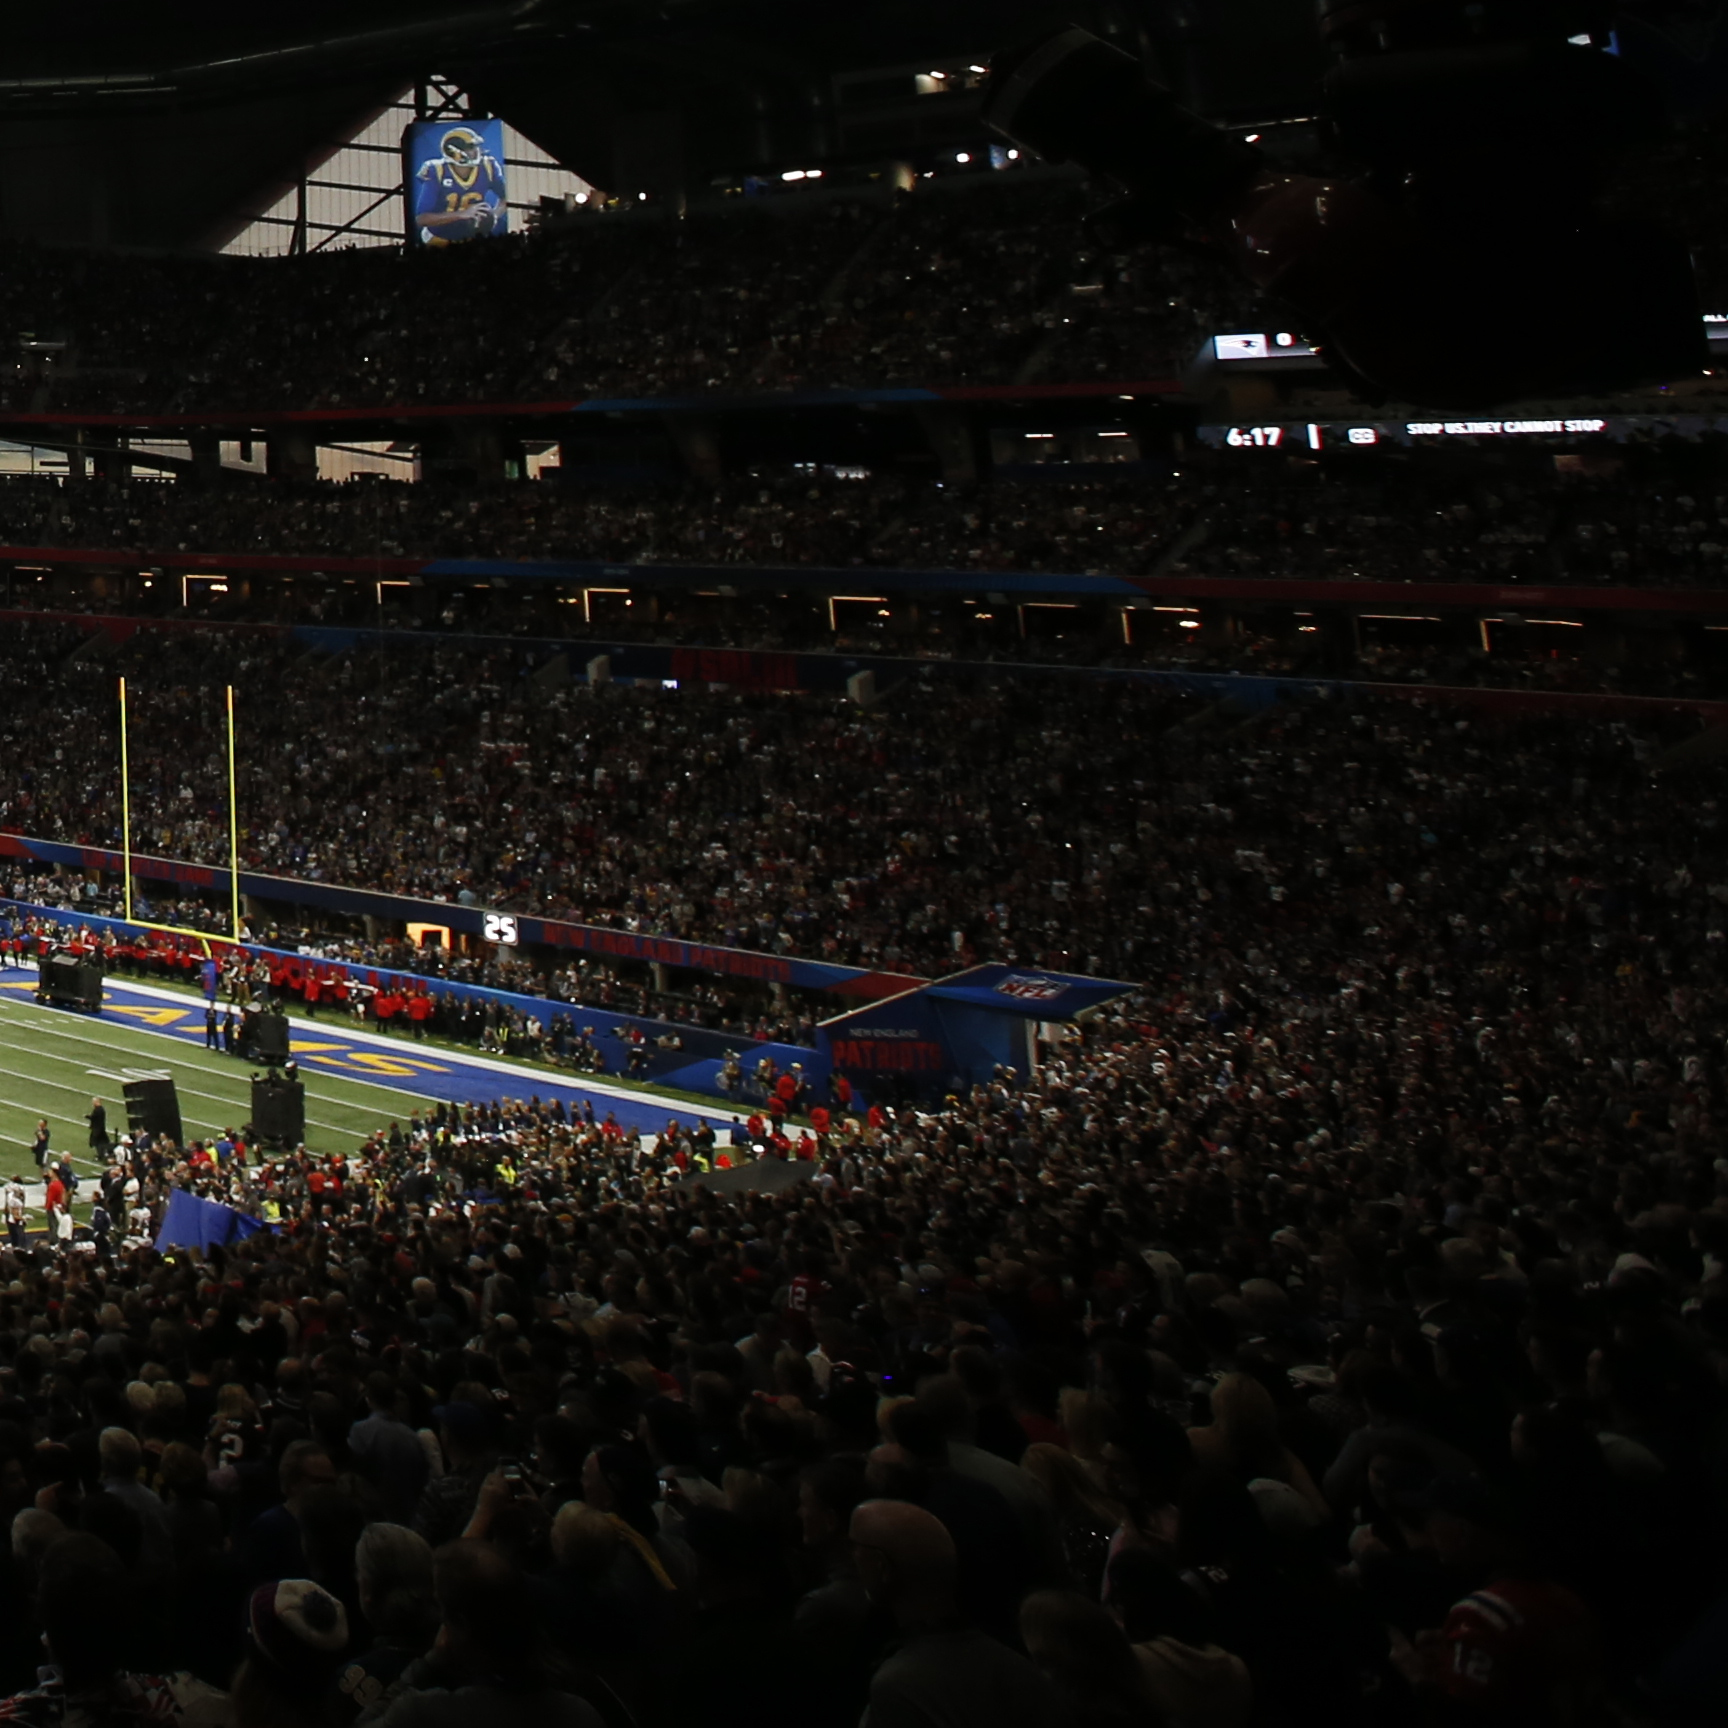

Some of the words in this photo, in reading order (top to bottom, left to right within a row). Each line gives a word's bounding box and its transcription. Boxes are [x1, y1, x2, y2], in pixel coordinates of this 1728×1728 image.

[1276, 332, 1293, 346] 0
[1227, 426, 1282, 446] 6:17
[1407, 423, 1443, 434] STOP
[1504, 421, 1562, 432] CANNOT
[1564, 420, 1604, 432] STOP
[485, 914, 517, 943] 25
[998, 981, 1049, 1000] NFL
[788, 1285, 807, 1312] 12
[1452, 1640, 1492, 1684] 12
